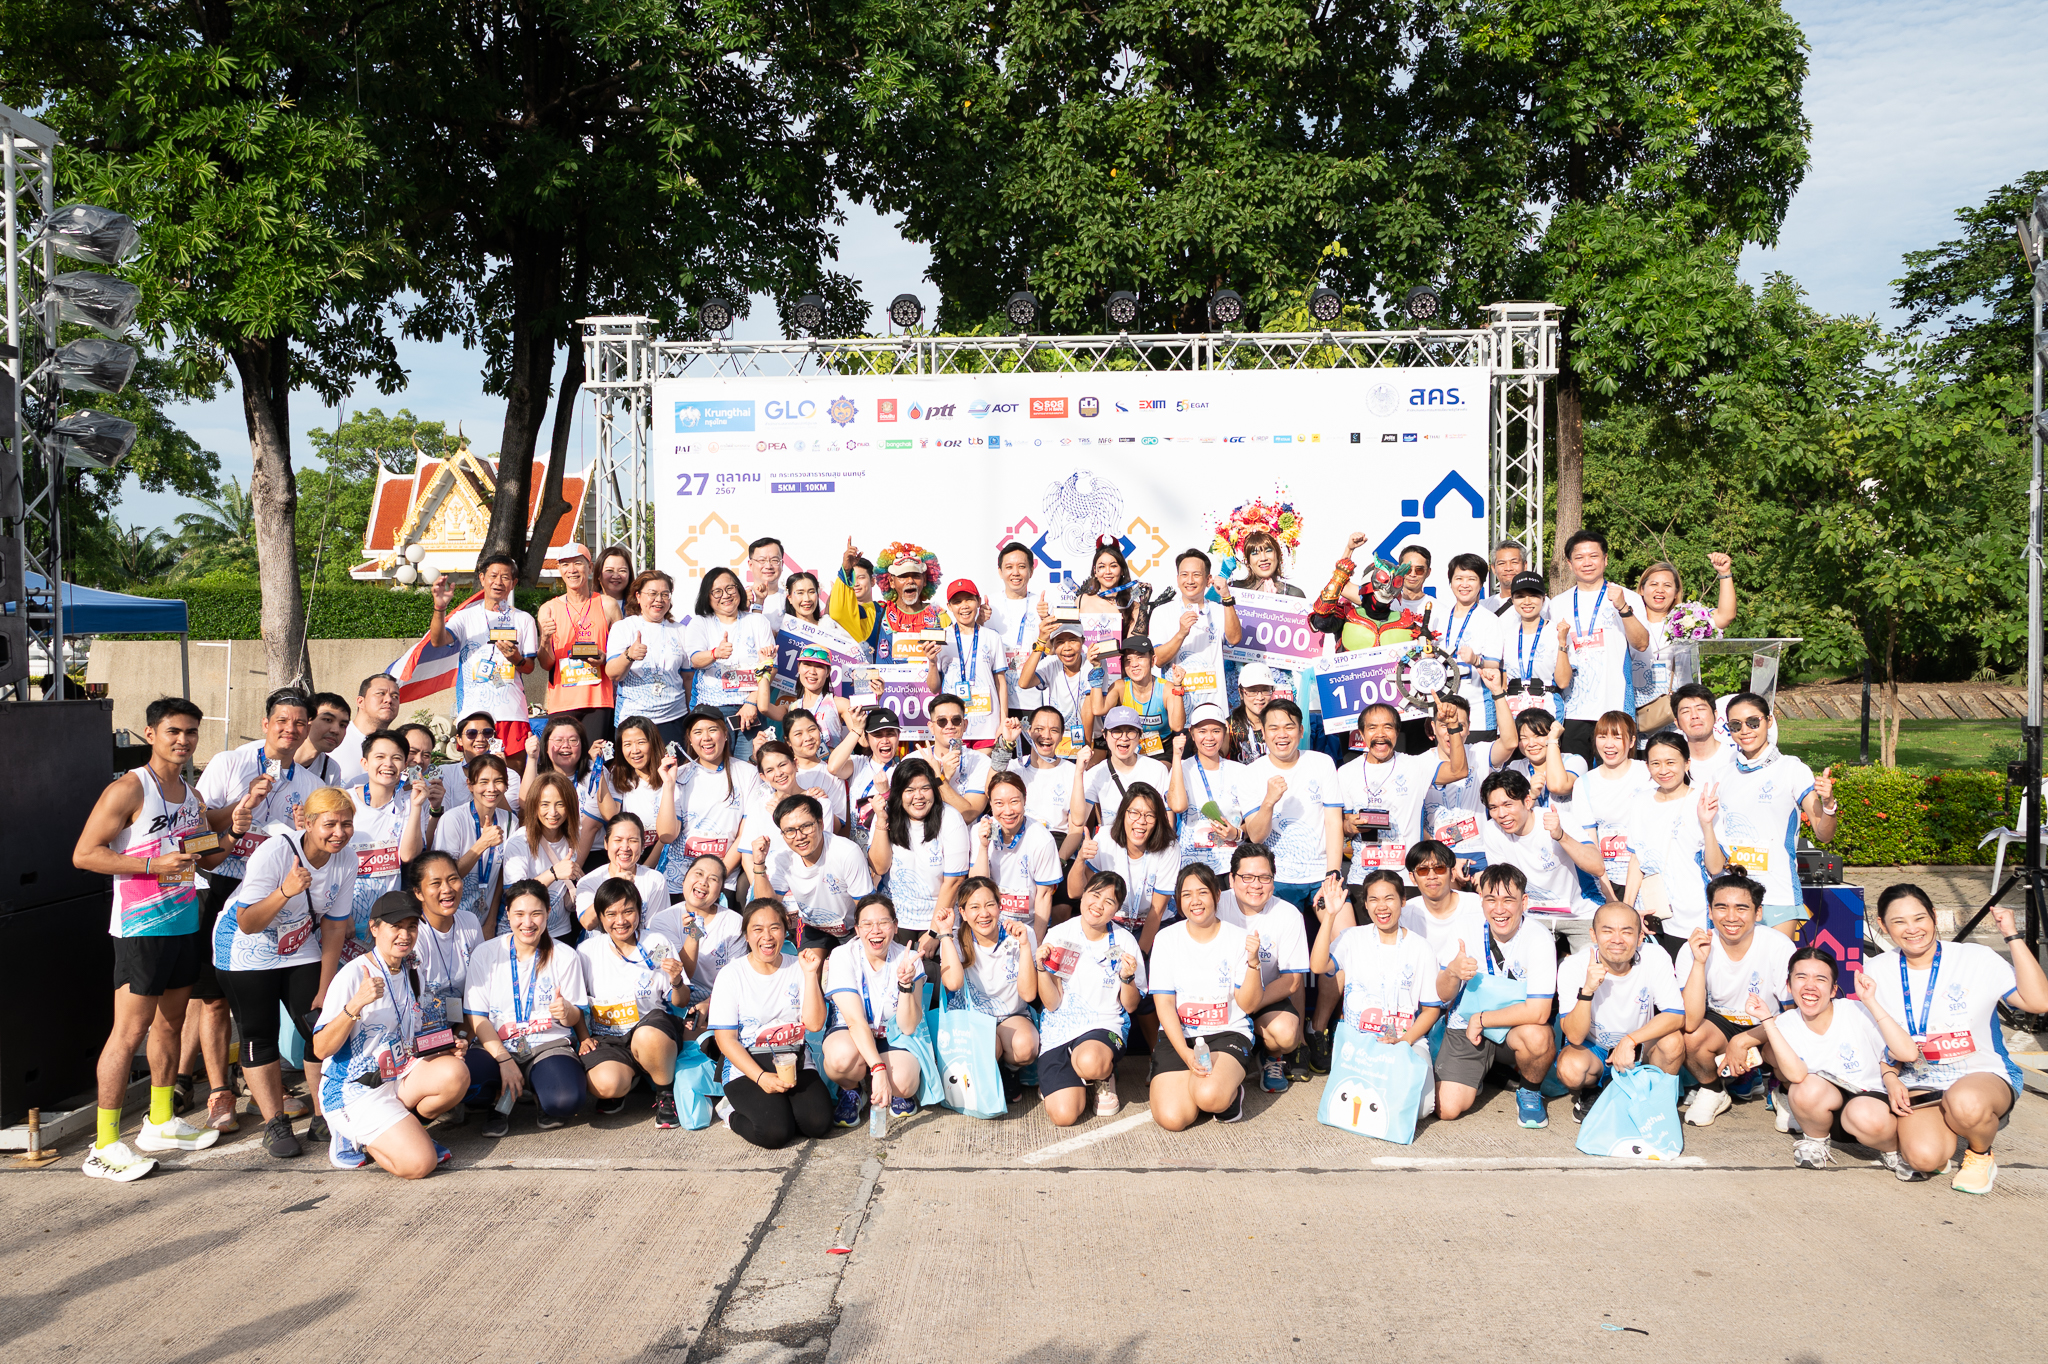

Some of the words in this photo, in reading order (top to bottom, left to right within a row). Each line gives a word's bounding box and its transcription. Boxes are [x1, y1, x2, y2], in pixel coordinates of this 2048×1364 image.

[1410, 388, 1465, 405] สคร.
[992, 403, 1019, 412] AOT
[1139, 400, 1166, 409] EXIM
[705, 408, 751, 419] Krungthai
[765, 400, 816, 419] GLO
[925, 403, 957, 421] ptt
[943, 440, 962, 448] OR
[716, 472, 761, 486] ตุลาคม
[676, 472, 709, 496] 27
[777, 484, 796, 492] 5KM
[805, 483, 828, 491] 10KM
[715, 487, 736, 495] 2567
[801, 624, 816, 634] SEPO
[1240, 619, 1311, 651] ,000
[897, 644, 922, 652] FANC
[1401, 644, 1433, 664] SEPO
[1333, 656, 1349, 664] SEPO
[482, 665, 488, 673] 3
[1194, 676, 1214, 684] 0010
[960, 687, 966, 695] 5
[1332, 679, 1398, 711] 1,00
[1075, 731, 1080, 740] 4
[187, 818, 204, 827] SEPO
[645, 834, 656, 842] 27
[246, 841, 259, 849] 01
[701, 843, 724, 852] 0118
[1605, 841, 1611, 849] F
[1367, 850, 1375, 858] M
[1378, 850, 1402, 858] 0167
[1737, 852, 1764, 863] 0014
[358, 856, 364, 865] F
[370, 854, 396, 864] 0094
[1542, 861, 1555, 870] SEPO
[1001, 898, 1025, 908] 0012
[289, 936, 295, 945] F
[342, 944, 358, 960] 216
[1949, 1002, 1967, 1011] SEPO
[607, 1007, 635, 1019] 0016
[1187, 1008, 1193, 1016] F
[1198, 1009, 1224, 1018] 0131
[1370, 1013, 1376, 1022] F
[776, 1027, 801, 1041] 0113
[418, 1039, 429, 1047] SEPO
[1933, 1039, 1970, 1050] 1066
[395, 1045, 402, 1057] 2
[386, 1056, 391, 1067] F
[1844, 1061, 1860, 1069] SEPO
[1639, 1112, 1665, 1133] ngthai
